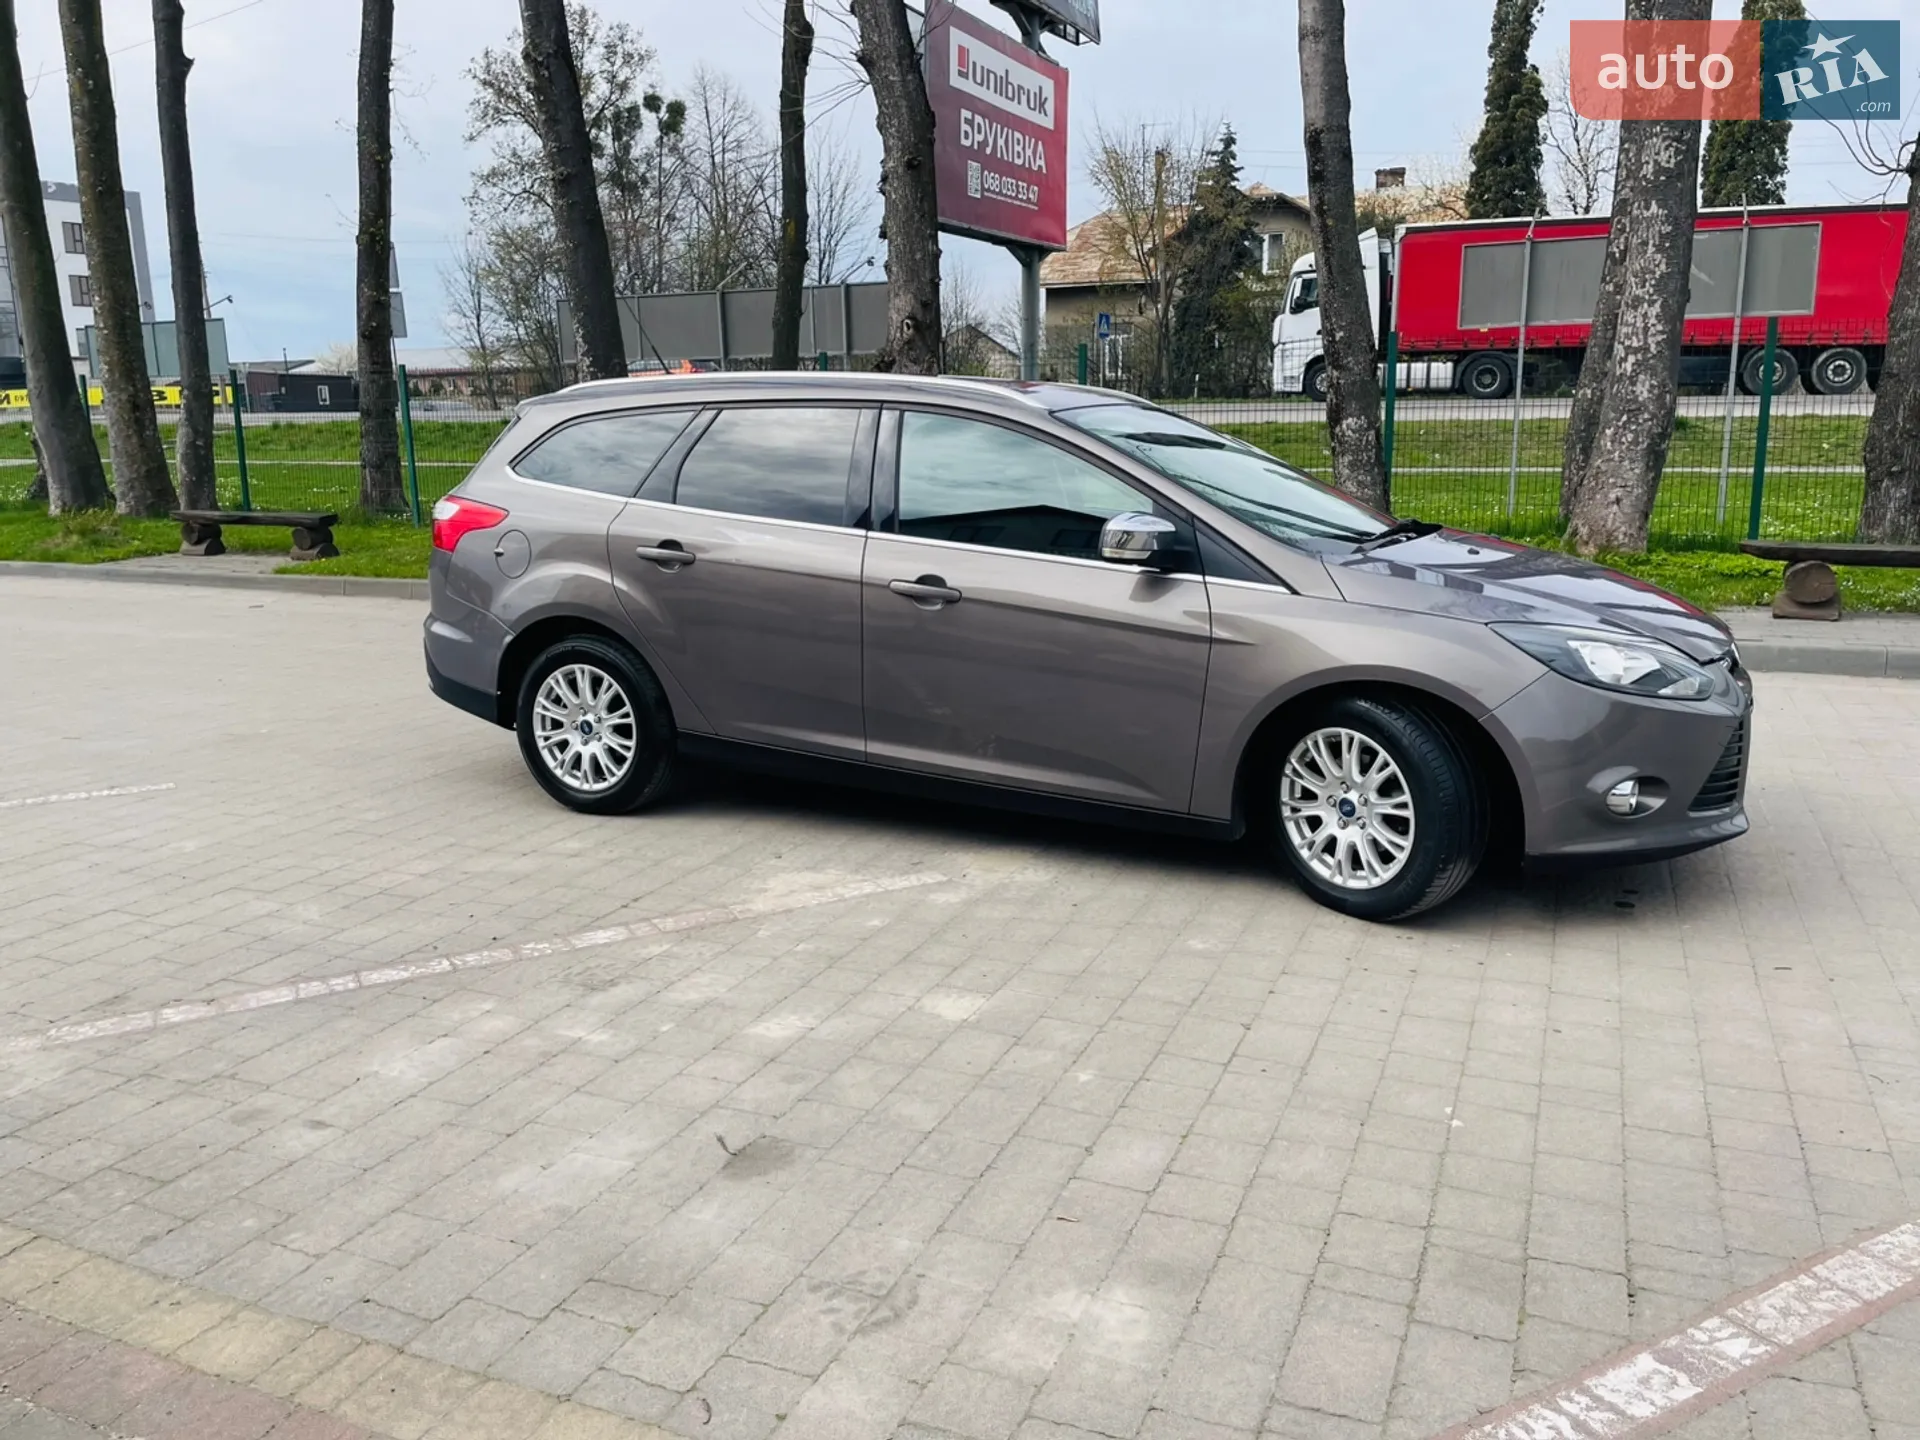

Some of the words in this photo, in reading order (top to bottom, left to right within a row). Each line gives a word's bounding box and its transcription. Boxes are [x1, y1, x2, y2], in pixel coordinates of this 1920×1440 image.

[972, 60, 1048, 117] unibruk
[960, 108, 1047, 174] БРУКІВКА
[983, 170, 1000, 192] 068
[1001, 176, 1017, 197] 033
[1018, 181, 1028, 200] 33
